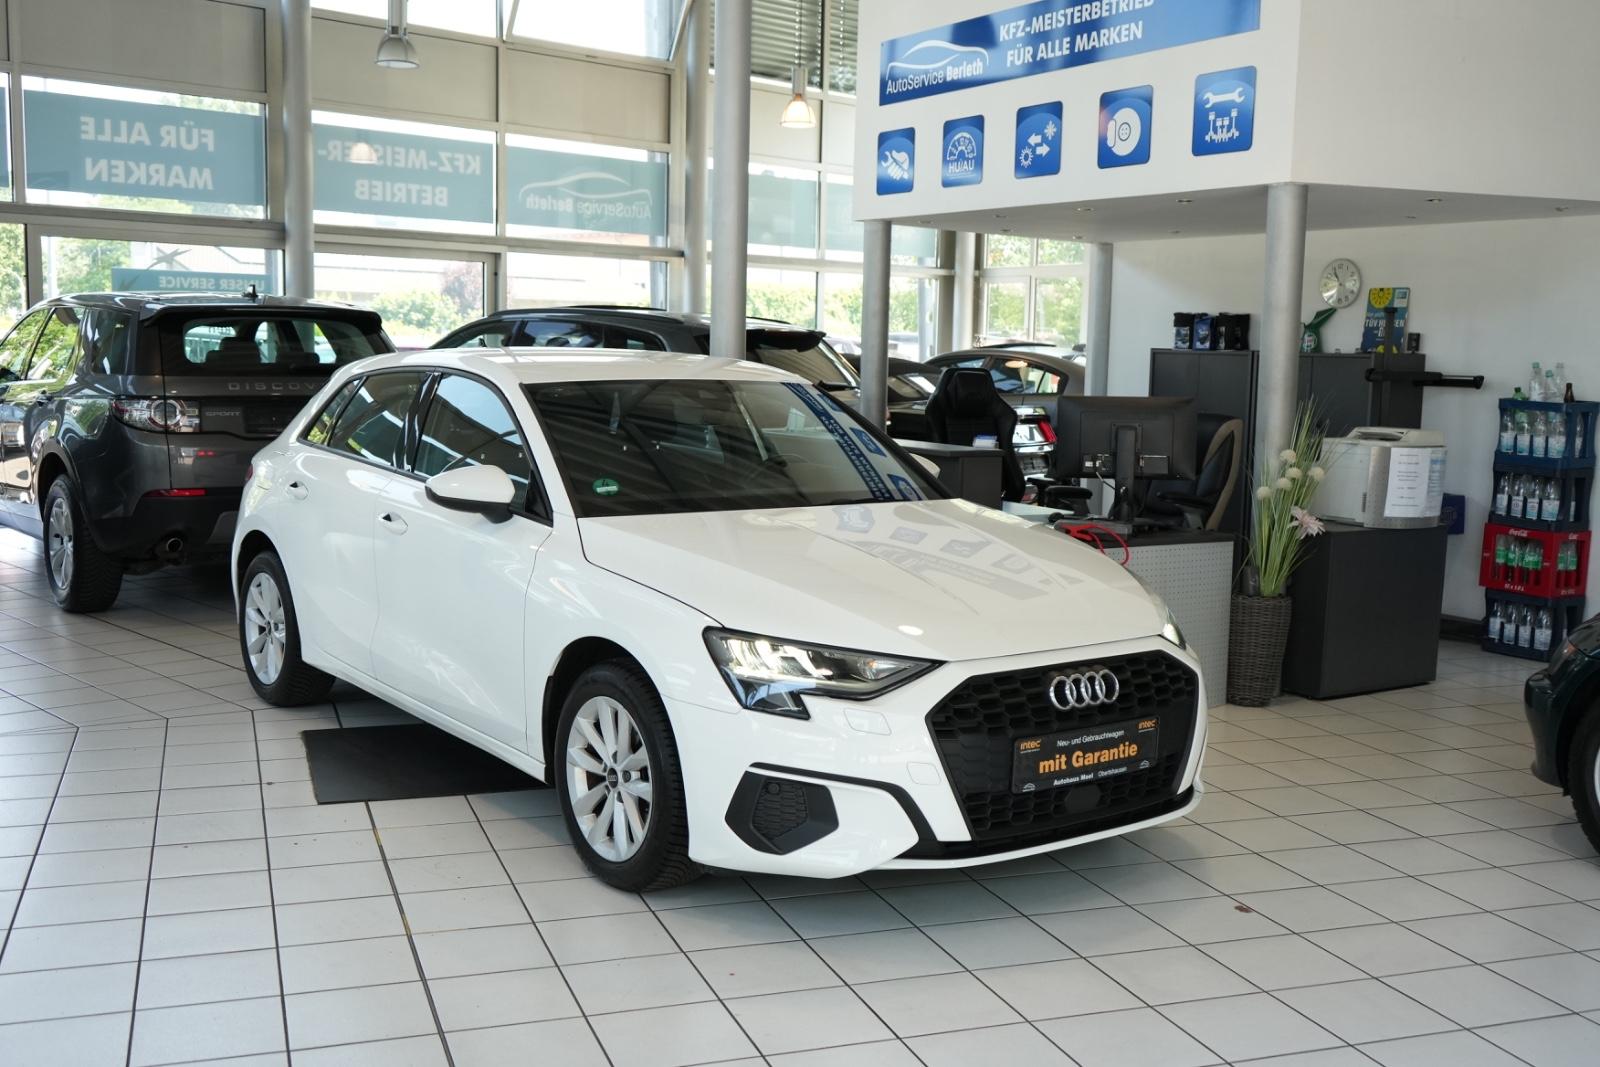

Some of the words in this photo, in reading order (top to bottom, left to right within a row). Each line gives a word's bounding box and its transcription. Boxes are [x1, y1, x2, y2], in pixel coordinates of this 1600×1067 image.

[1006, 43, 1033, 68] FÜR
[1036, 36, 1071, 62] ALLE
[1074, 20, 1144, 54] MARKEN
[886, 69, 945, 95] AutoService
[945, 57, 984, 82] Berleth
[227, 382, 316, 391] DISCOV
[1038, 754, 1068, 774] mit
[1071, 741, 1139, 768] Garantie
[1071, 737, 1082, 746] und
